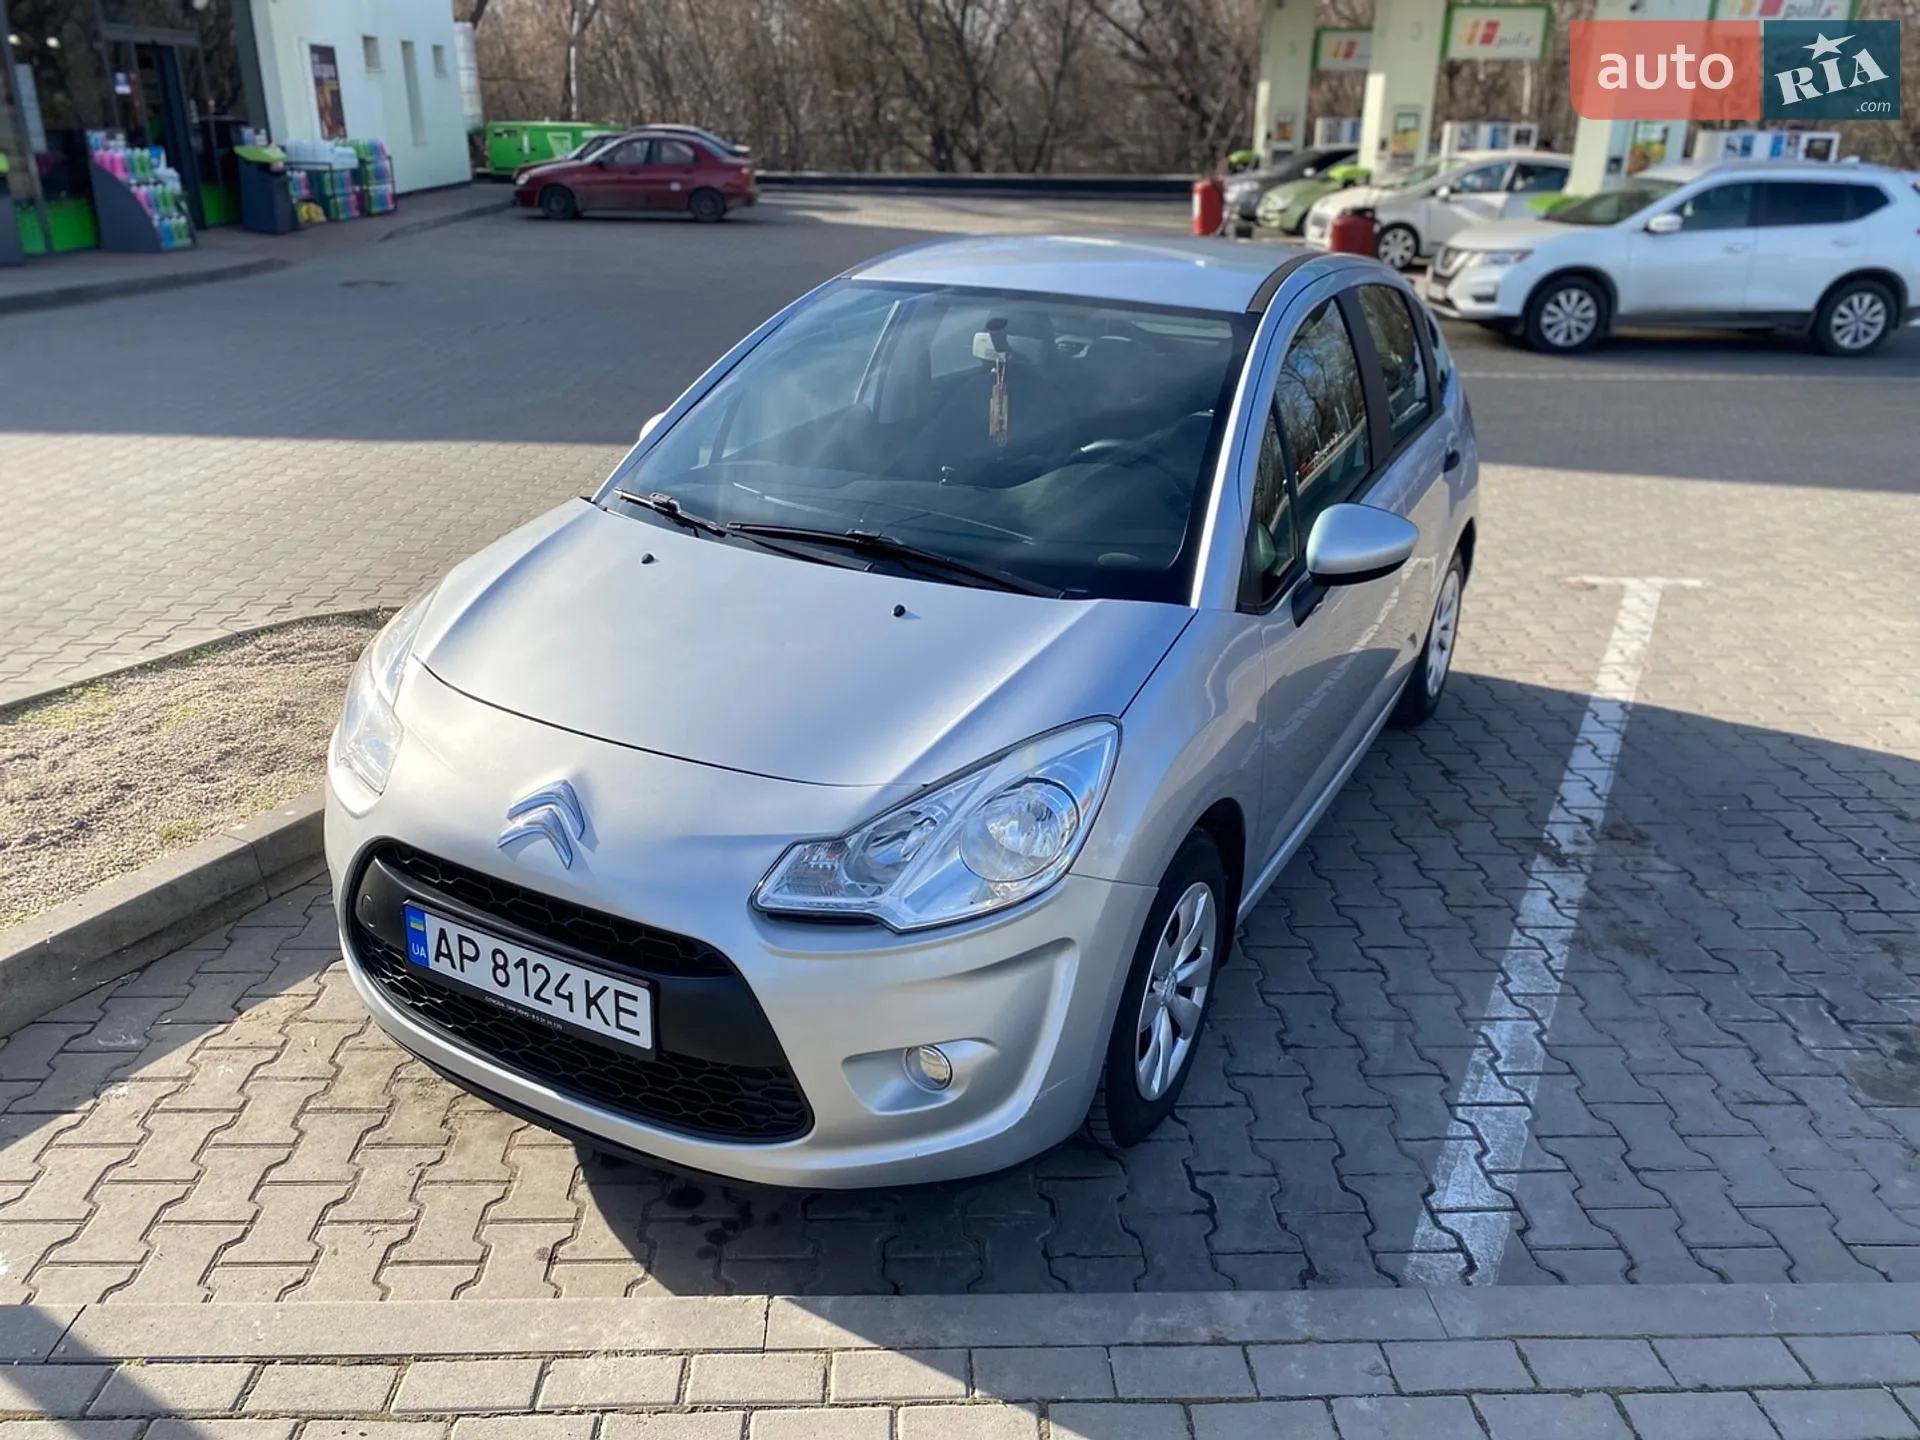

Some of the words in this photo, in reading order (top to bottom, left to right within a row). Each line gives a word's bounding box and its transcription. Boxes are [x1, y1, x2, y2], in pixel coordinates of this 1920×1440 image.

[412, 943, 427, 959] UA
[434, 928, 480, 973] AP
[491, 948, 574, 1013] 8124
[585, 979, 640, 1036] KE
